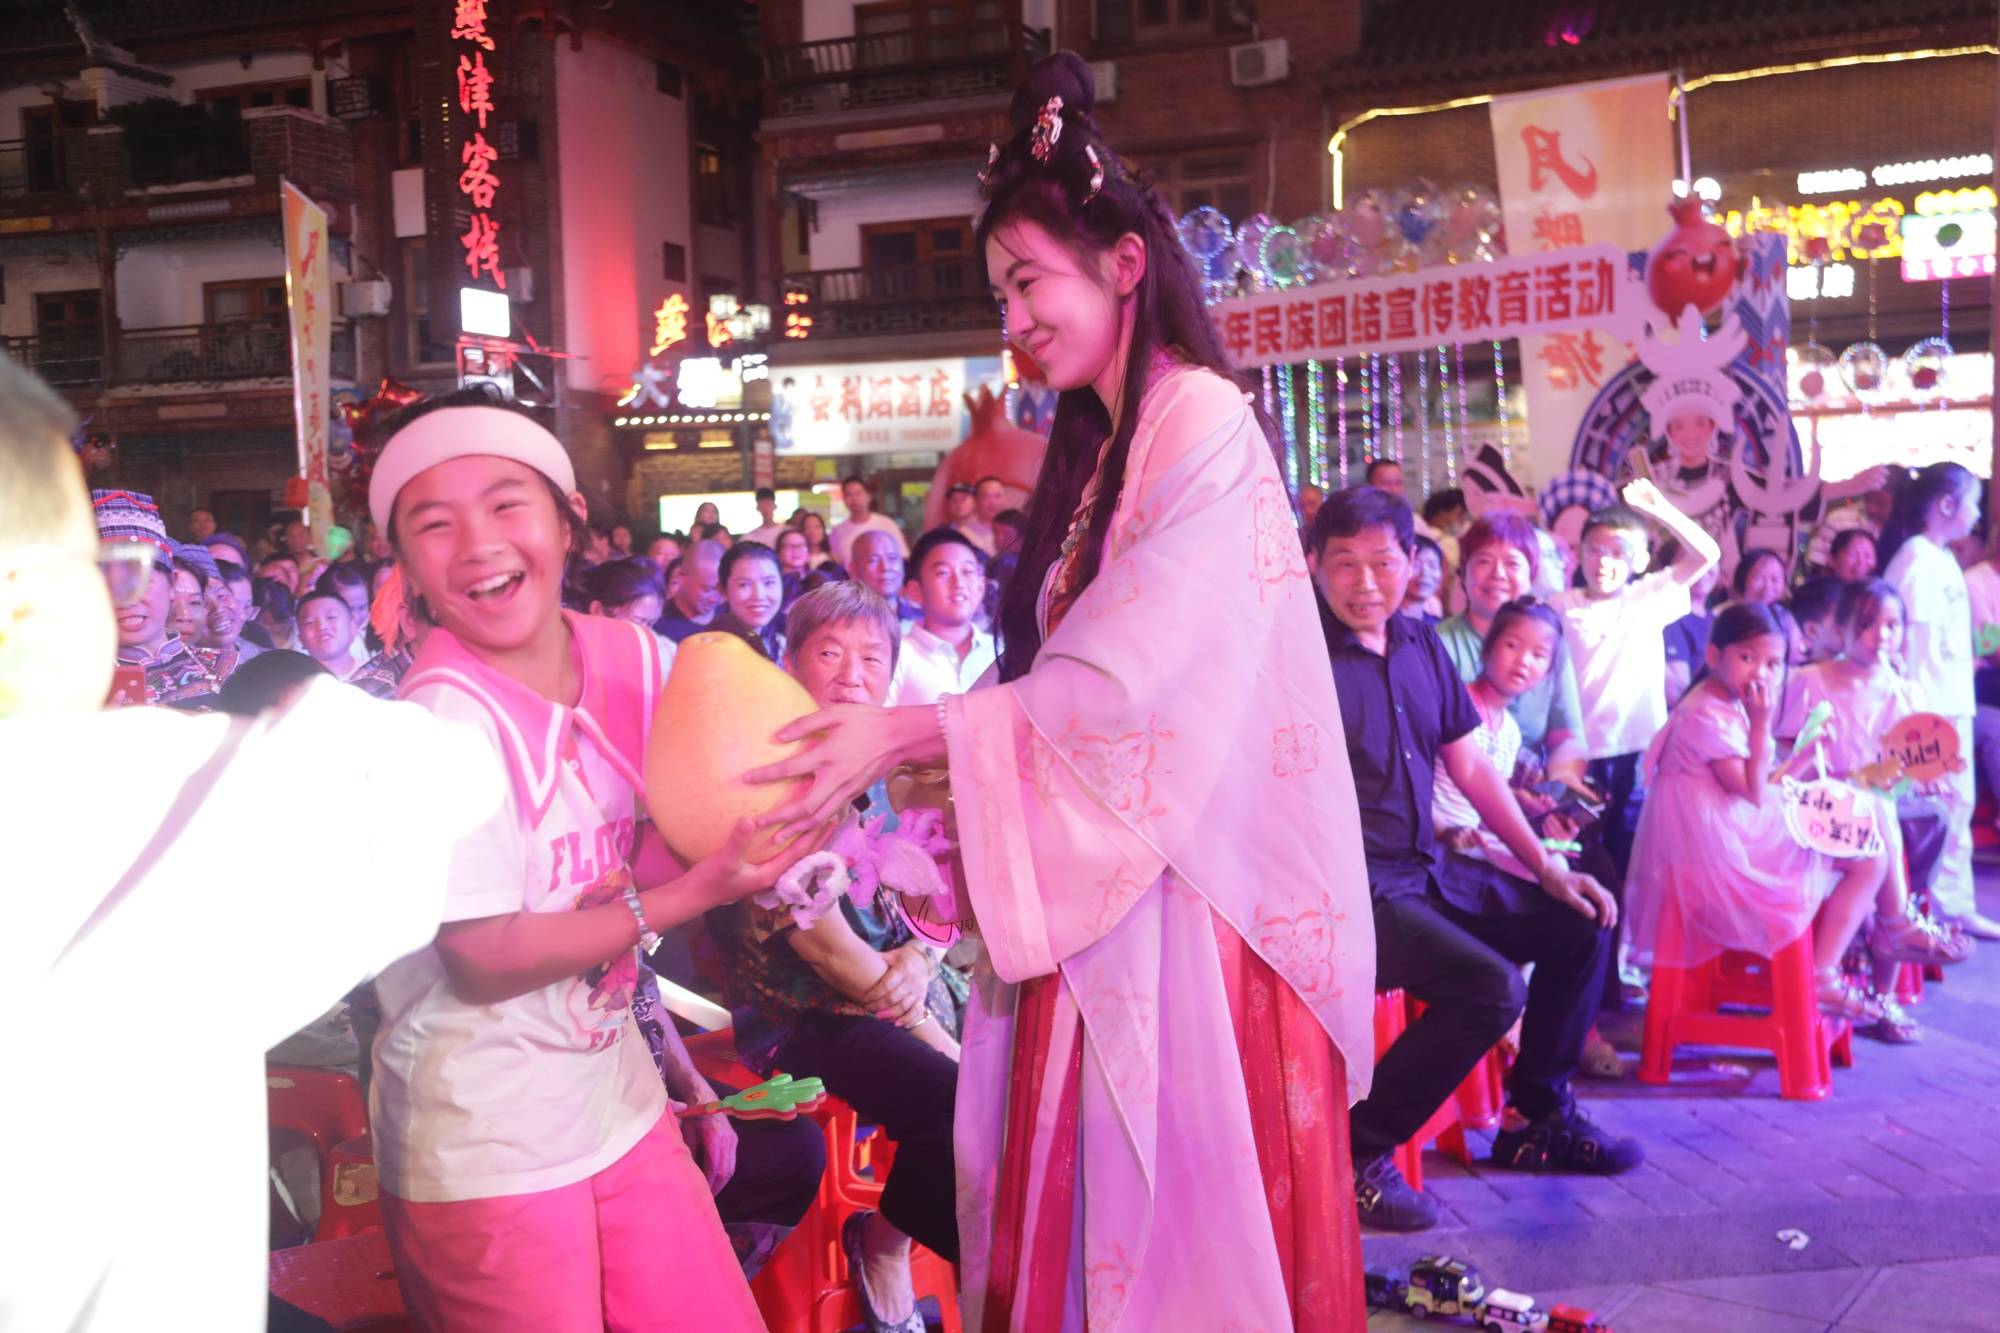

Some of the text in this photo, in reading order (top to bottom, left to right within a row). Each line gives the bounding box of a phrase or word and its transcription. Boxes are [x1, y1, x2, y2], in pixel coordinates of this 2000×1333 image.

[1212, 256, 1616, 359] 年民族团结宣传教育活动
